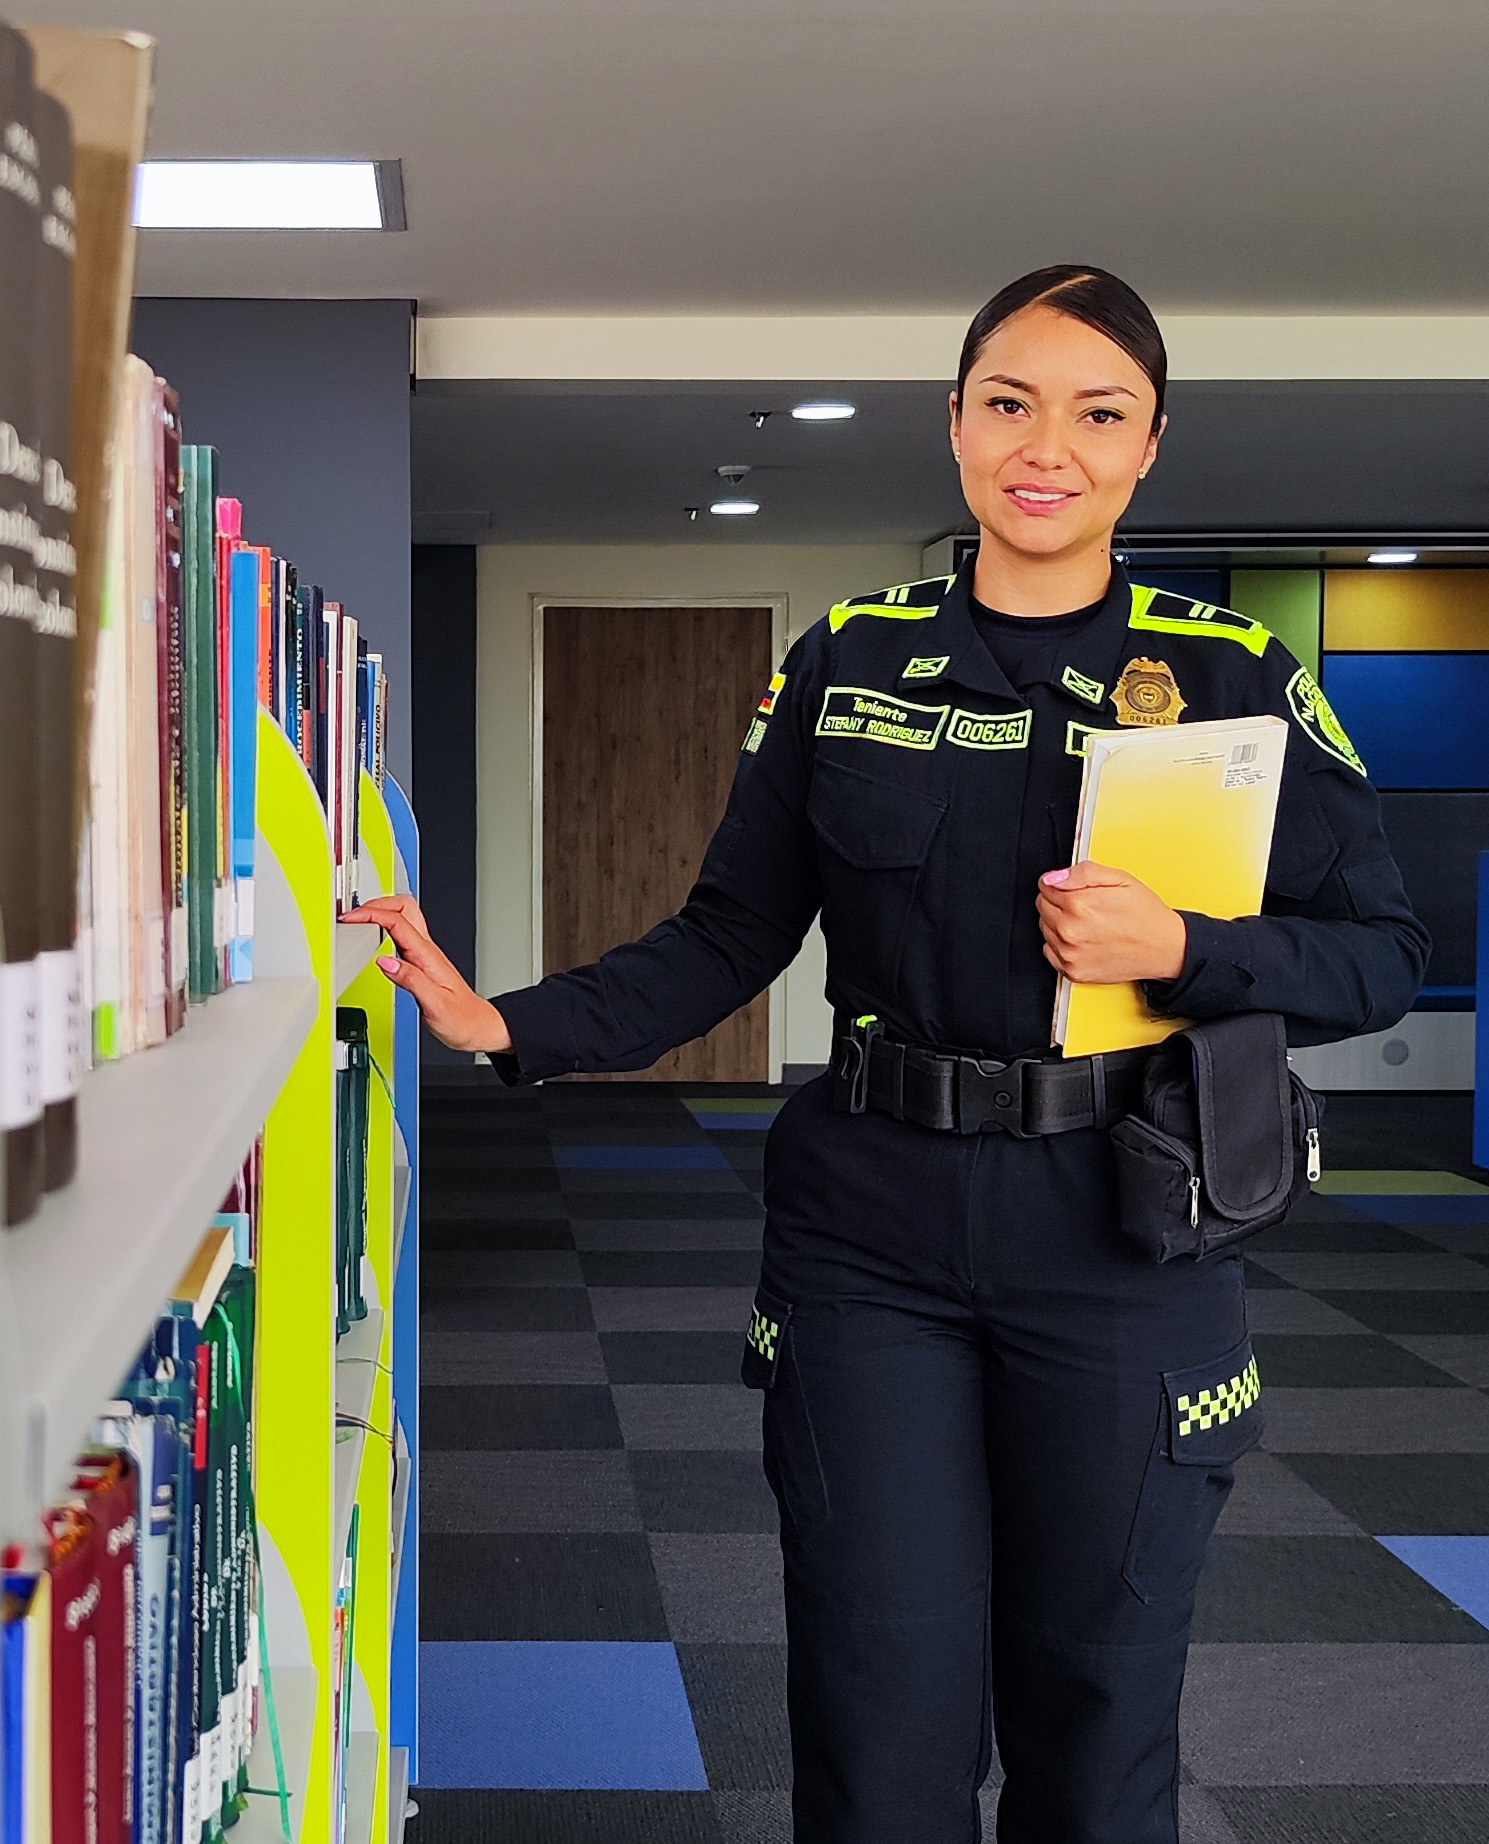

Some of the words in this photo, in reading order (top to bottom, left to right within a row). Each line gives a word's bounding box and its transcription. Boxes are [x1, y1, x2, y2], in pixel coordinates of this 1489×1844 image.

[853, 697, 908, 721] Teniente
[1129, 715, 1167, 725] 006261
[823, 715, 865, 732] STEFANY
[866, 719, 933, 743] RODRIGUEZ
[956, 720, 1024, 743] 006261
